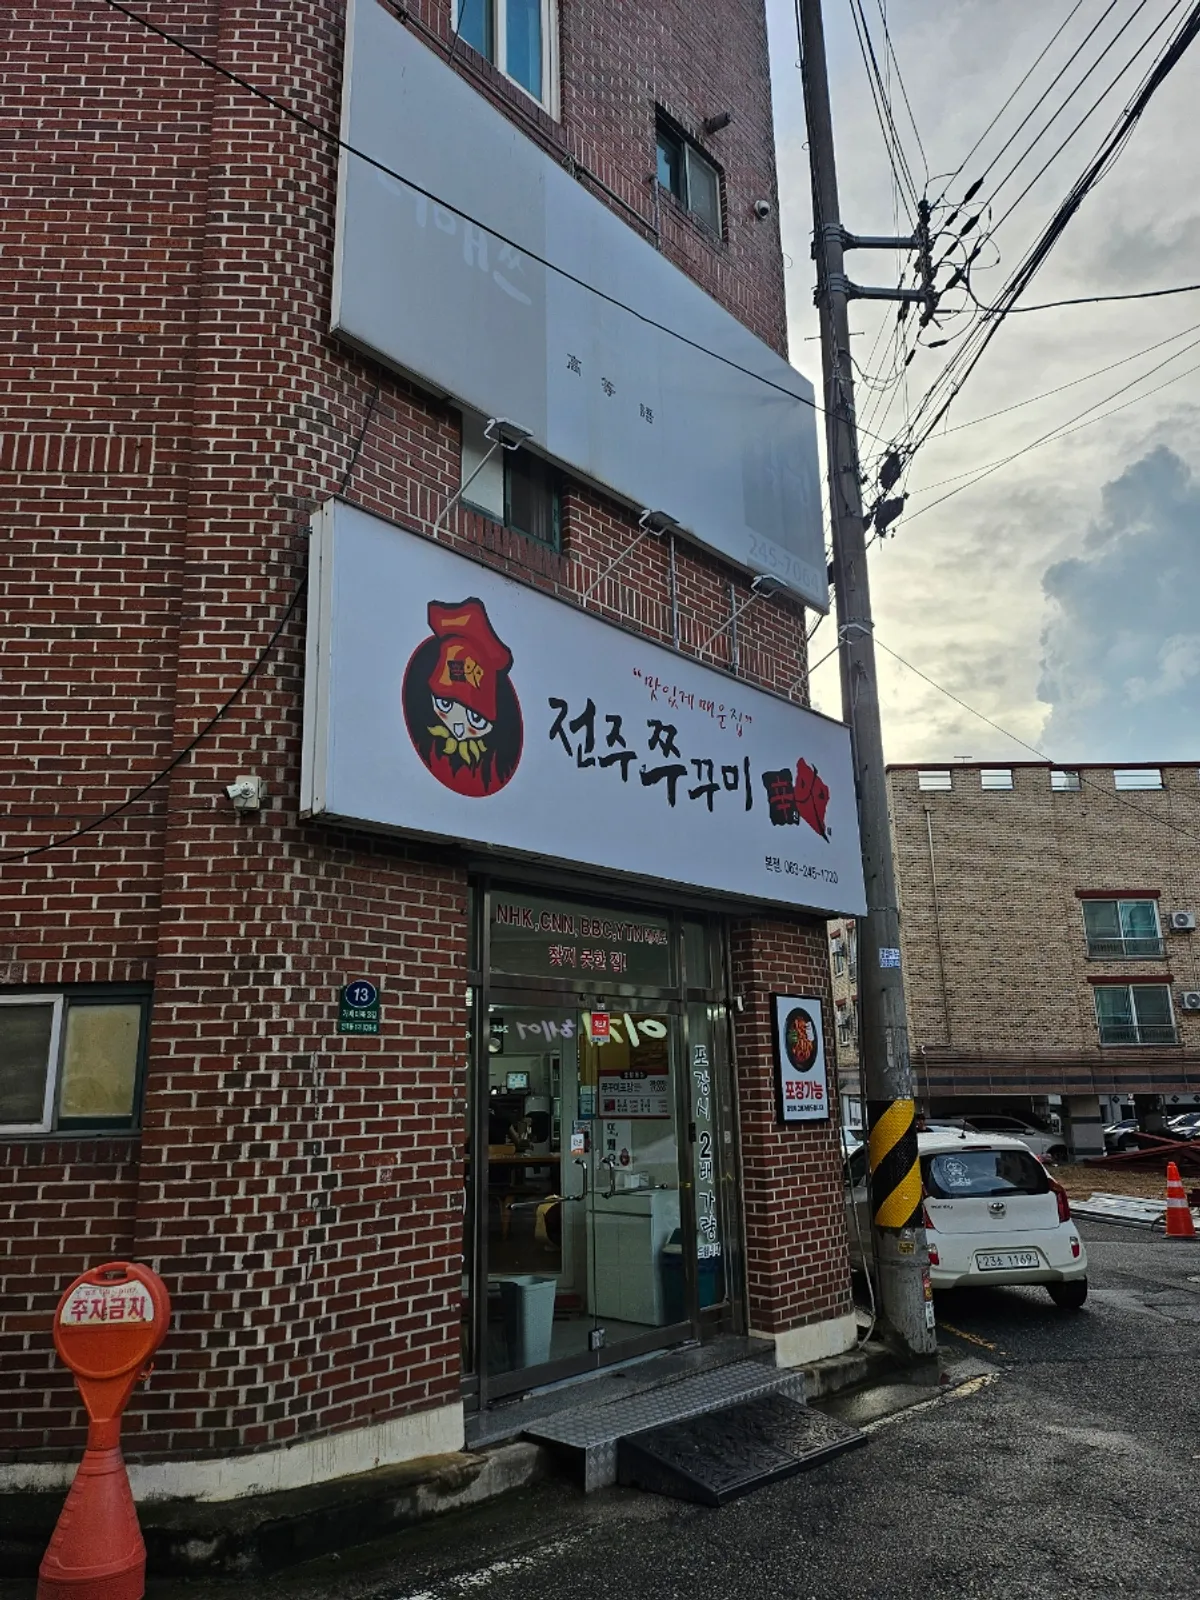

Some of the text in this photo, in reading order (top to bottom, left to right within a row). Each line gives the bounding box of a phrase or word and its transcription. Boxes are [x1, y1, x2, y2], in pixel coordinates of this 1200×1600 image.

[784, 860, 839, 884] 063-245-1720
[353, 987, 370, 1002] 13
[785, 1080, 824, 1101] 포장가능
[1007, 1253, 1032, 1266] 1169
